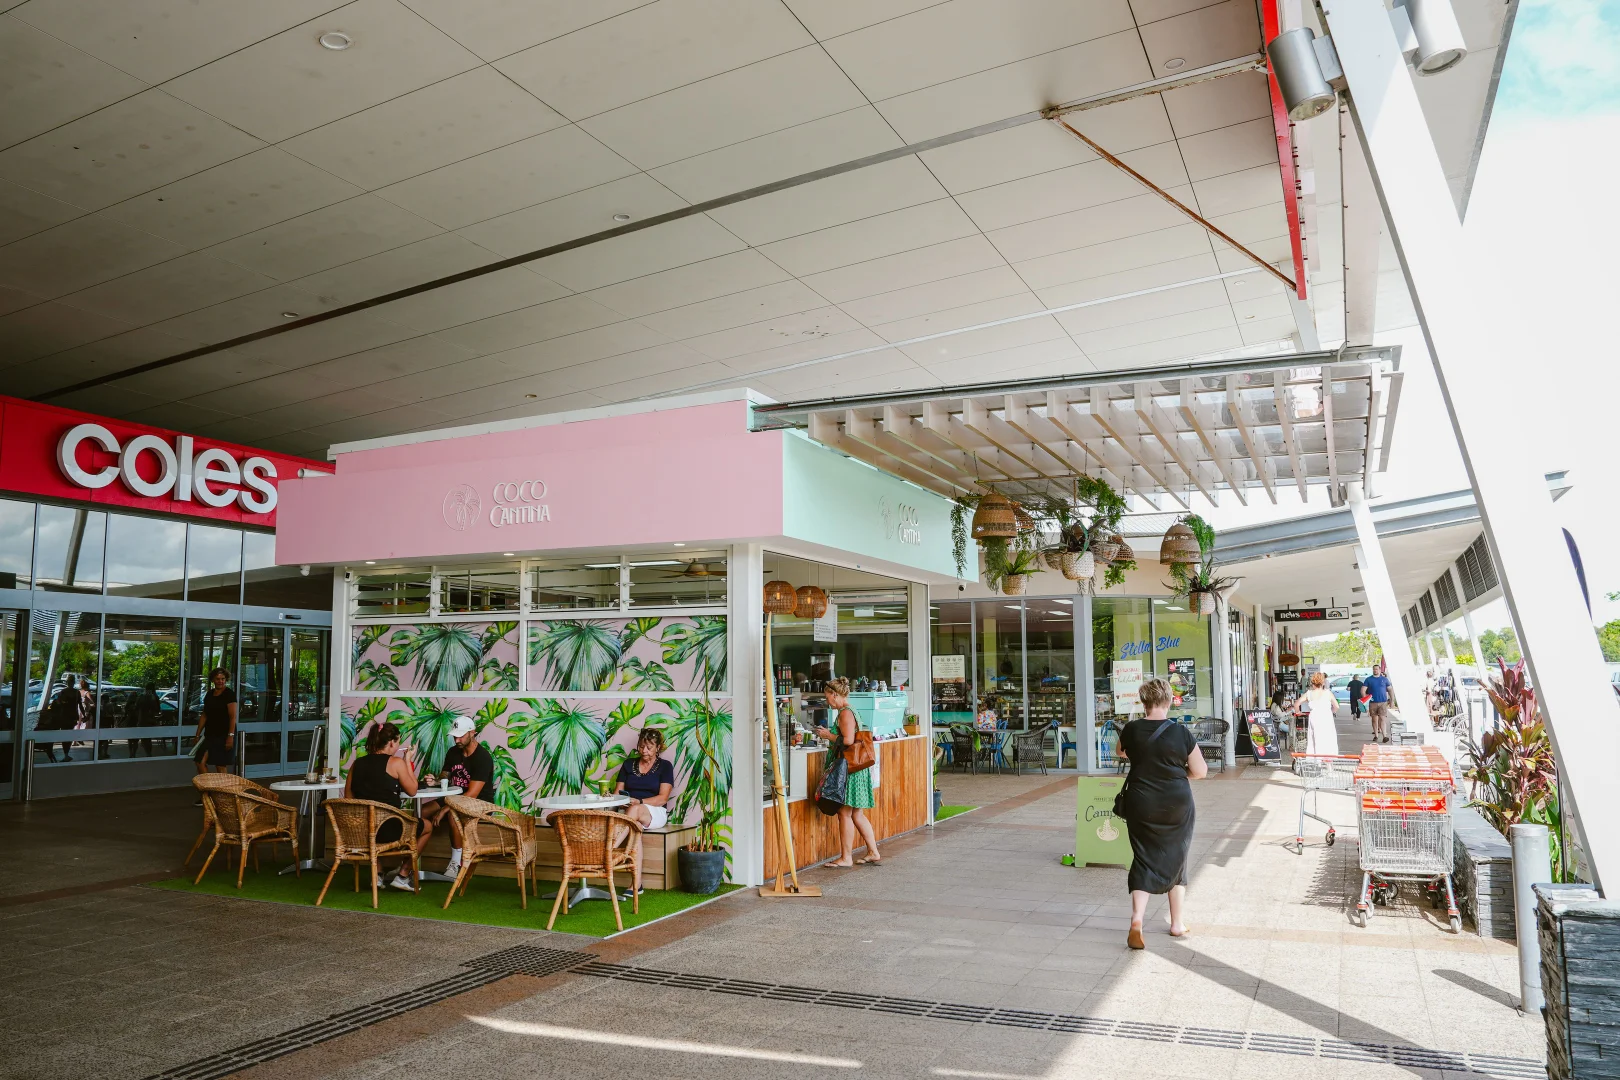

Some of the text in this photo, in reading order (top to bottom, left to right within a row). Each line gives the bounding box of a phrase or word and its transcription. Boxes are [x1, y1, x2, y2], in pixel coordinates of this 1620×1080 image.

[57, 423, 278, 513] coles
[493, 480, 547, 505] COCO
[489, 505, 551, 528] CANTINA
[1120, 635, 1181, 659] Stella Blue
[1251, 711, 1271, 719] LOADED
